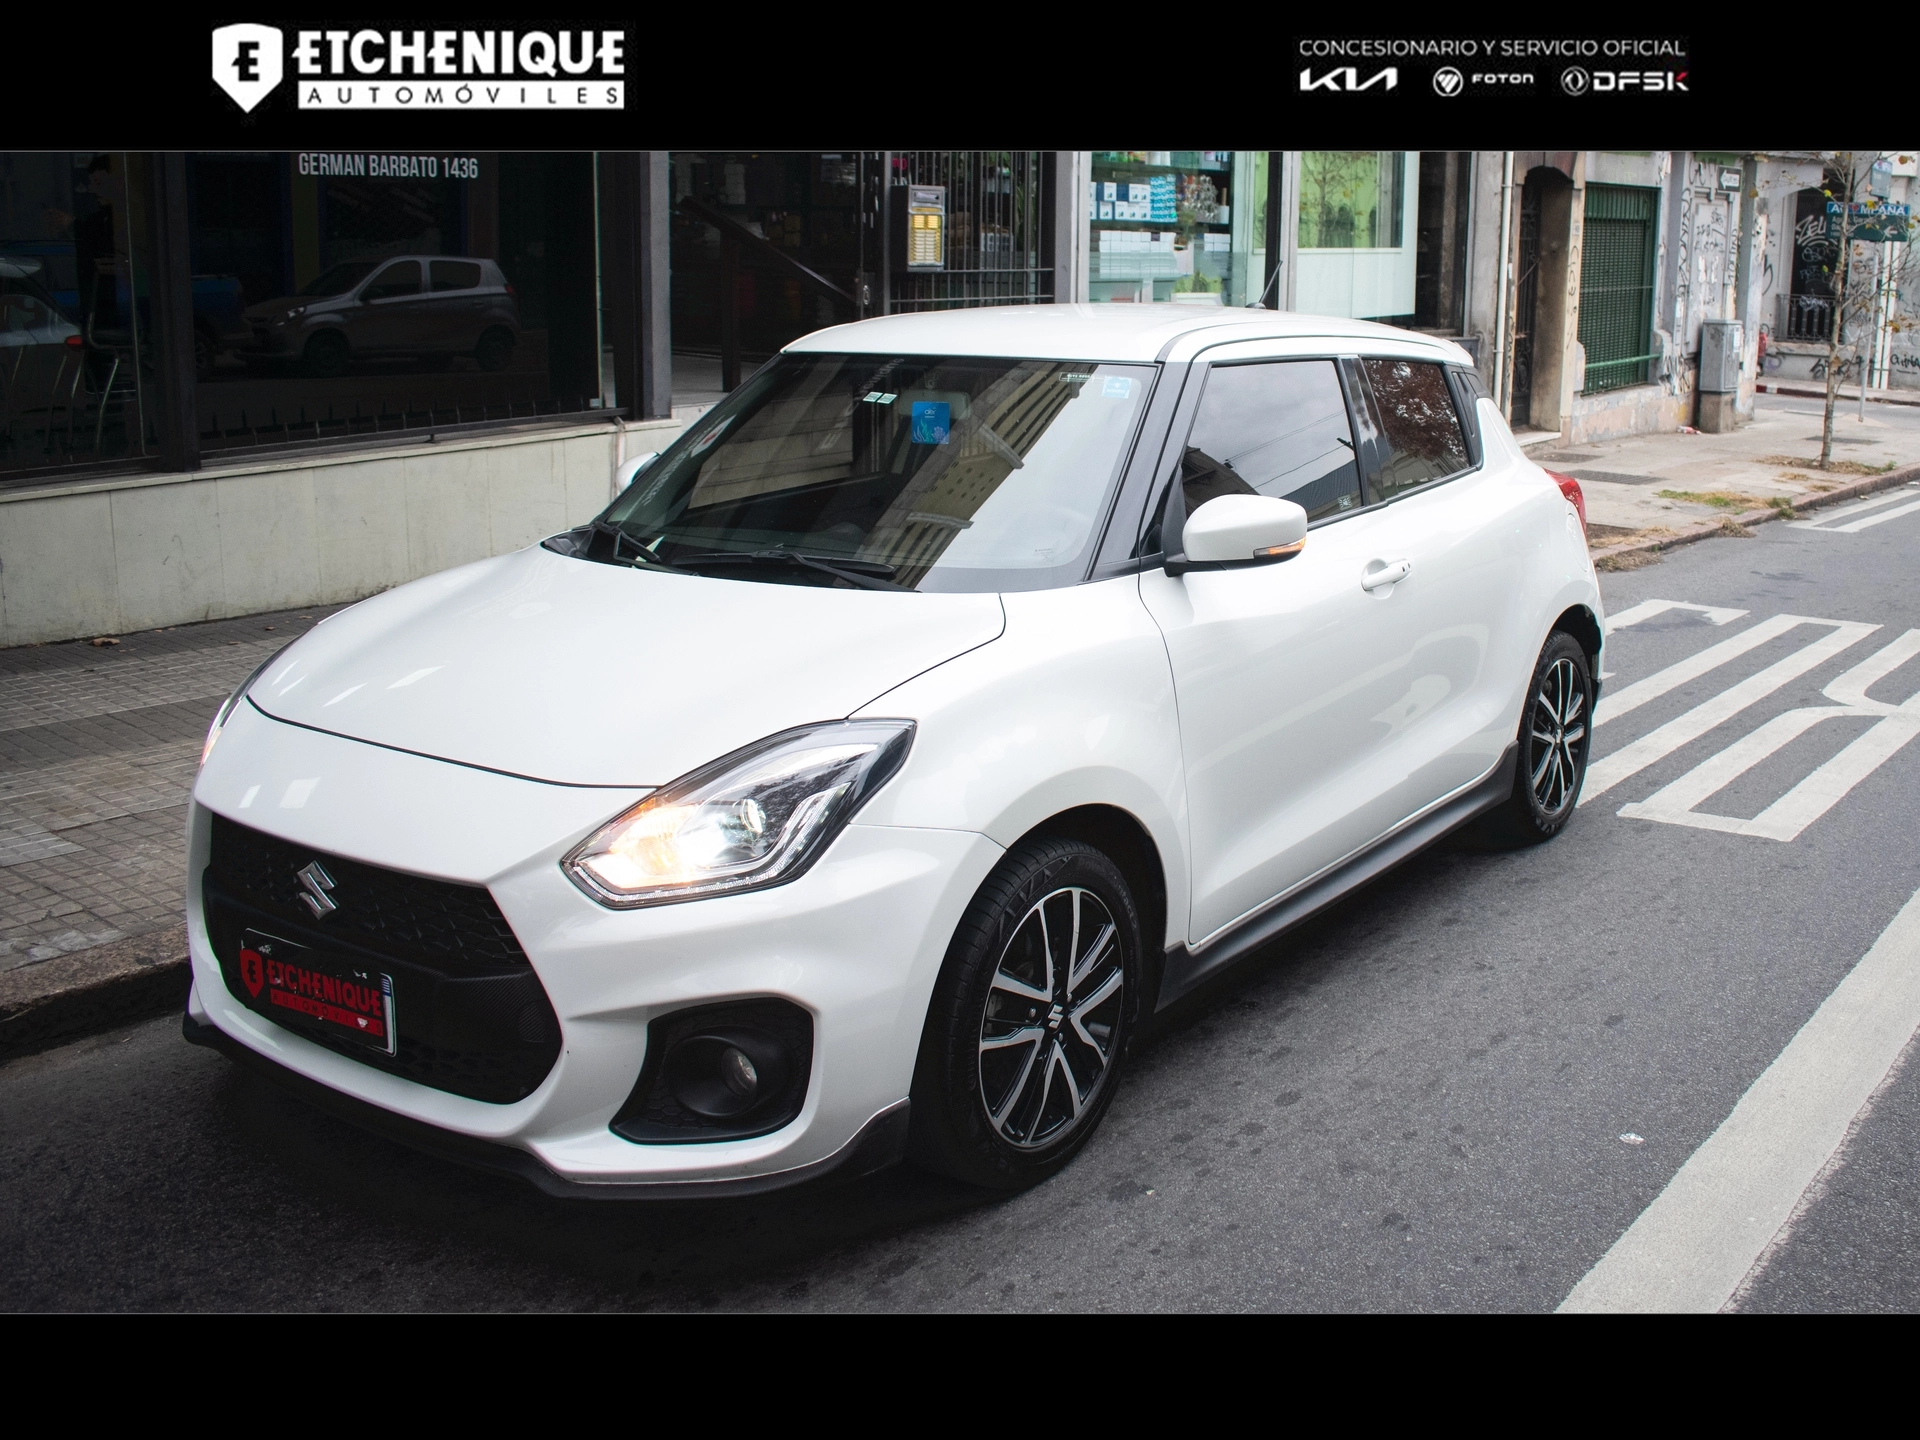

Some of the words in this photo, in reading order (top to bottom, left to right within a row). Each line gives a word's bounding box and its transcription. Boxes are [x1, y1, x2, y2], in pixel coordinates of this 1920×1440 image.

[298, 153, 364, 176] GERMAN
[369, 155, 437, 178] BARBATO
[442, 157, 479, 179] 1436
[266, 959, 383, 1017] ETCHENIQUE
